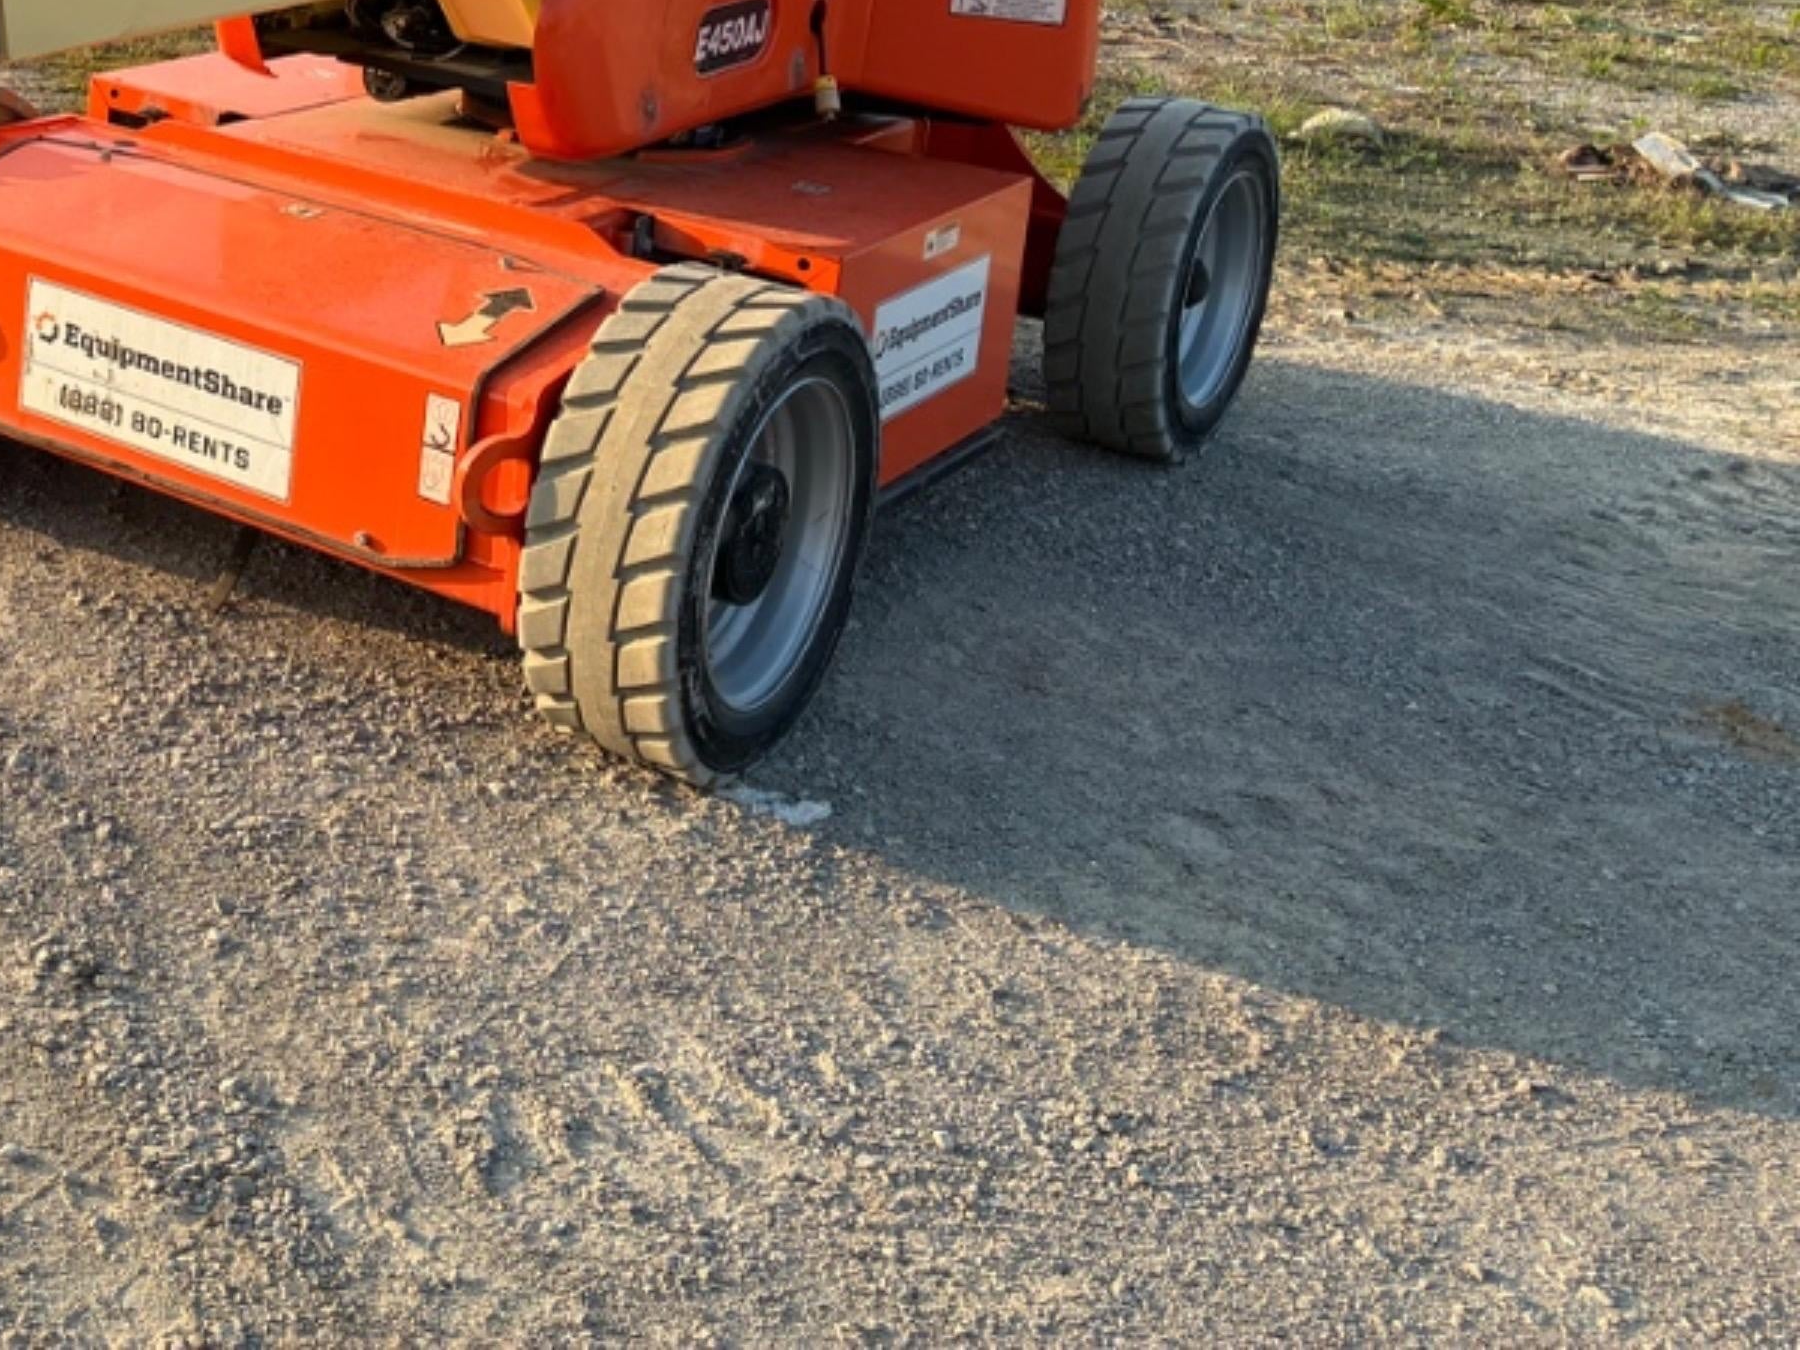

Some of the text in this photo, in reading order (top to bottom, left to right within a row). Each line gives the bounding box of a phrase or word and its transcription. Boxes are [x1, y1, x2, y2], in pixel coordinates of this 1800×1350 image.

[695, 9, 770, 61] E450AJ
[64, 322, 283, 416] EquipmentShare
[59, 384, 251, 471] (888) 80-RENTS
